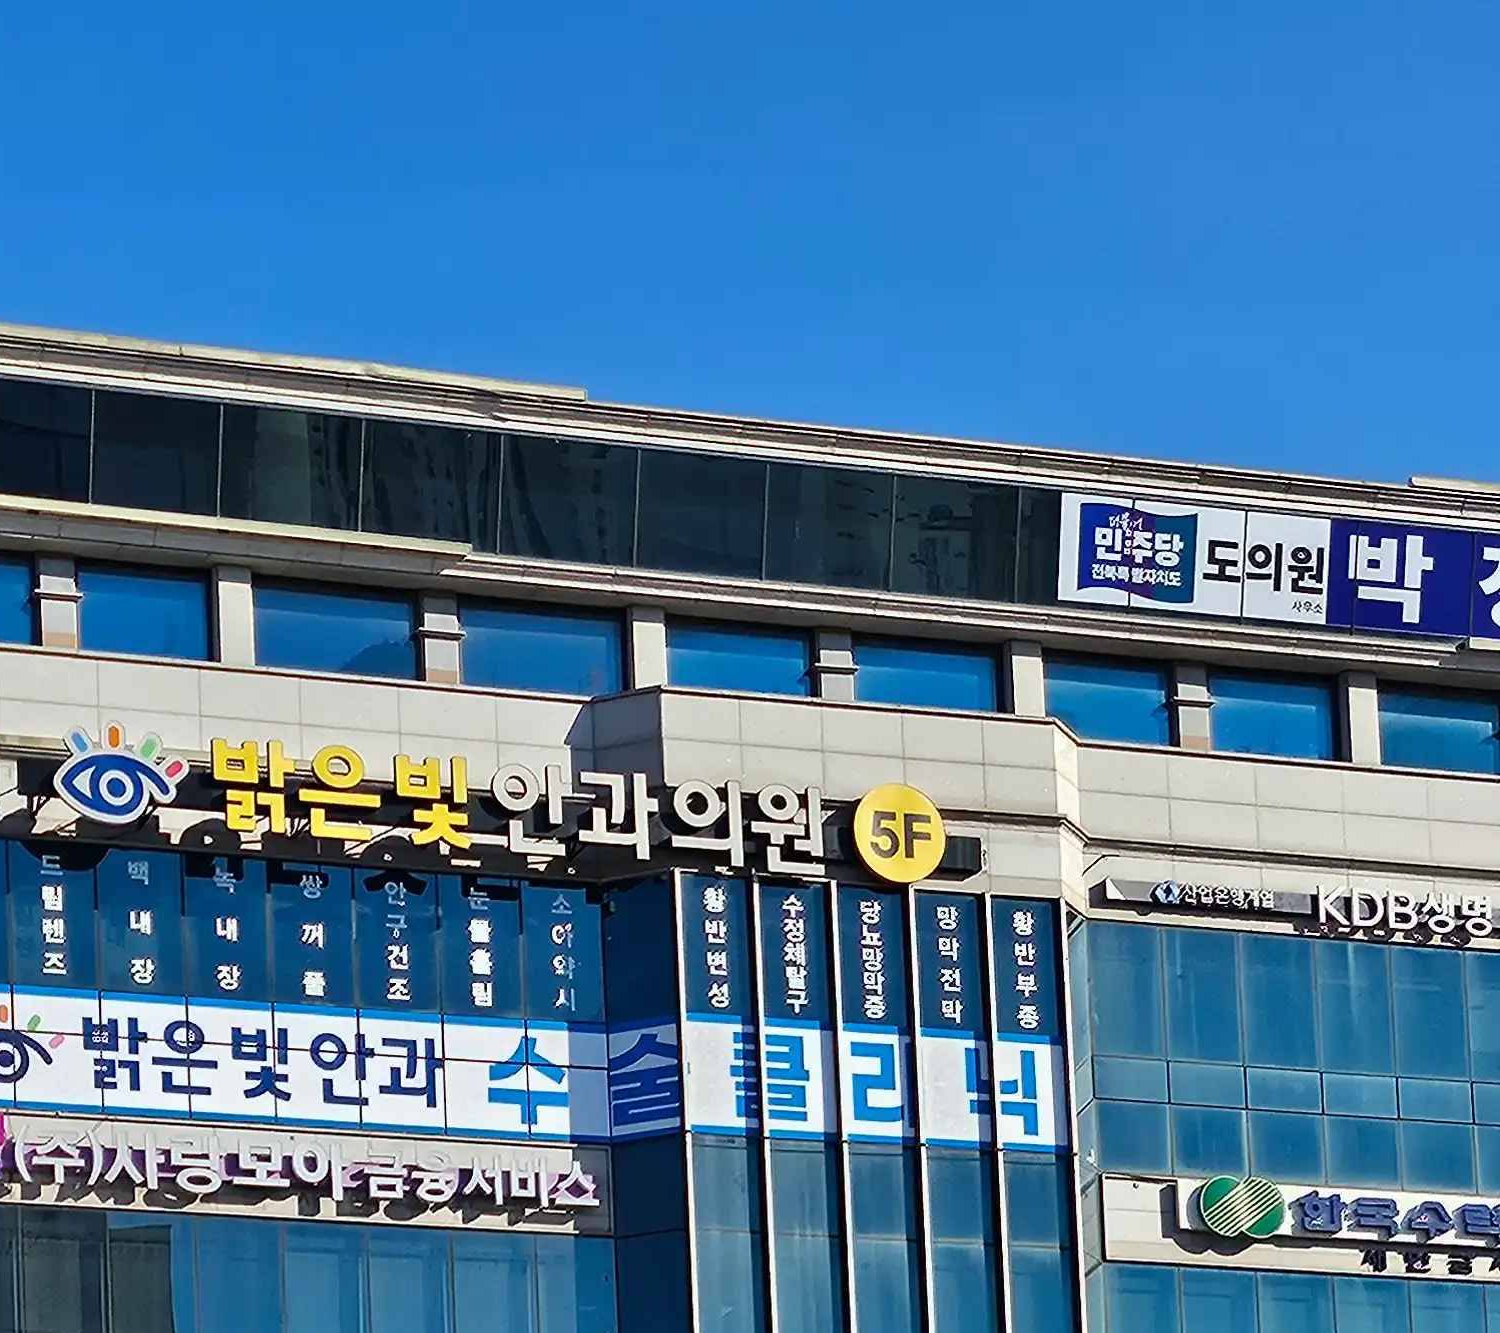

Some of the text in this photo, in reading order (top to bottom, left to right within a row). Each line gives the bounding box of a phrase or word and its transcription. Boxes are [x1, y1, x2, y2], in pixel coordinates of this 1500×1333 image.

[1094, 526, 1184, 567] 민주당
[1202, 539, 1325, 595] 도의원
[869, 811, 932, 860] 5F
[39, 854, 68, 976] 드림렌즈
[127, 860, 156, 985] 백내장
[213, 856, 242, 991] 녹내장
[299, 874, 327, 998] 쌍꺼풀
[385, 881, 412, 1002] 안구건조
[550, 893, 577, 1012] 소아약시
[702, 885, 731, 1009] 황반변성
[781, 893, 810, 1015] 수정체탈구
[858, 899, 888, 1020] 당뇨망막증
[935, 905, 965, 1026] 망막전막
[1012, 909, 1041, 1030] 황반부종
[82, 1016, 1042, 1137] 밝은빛안과 수술클리닉
